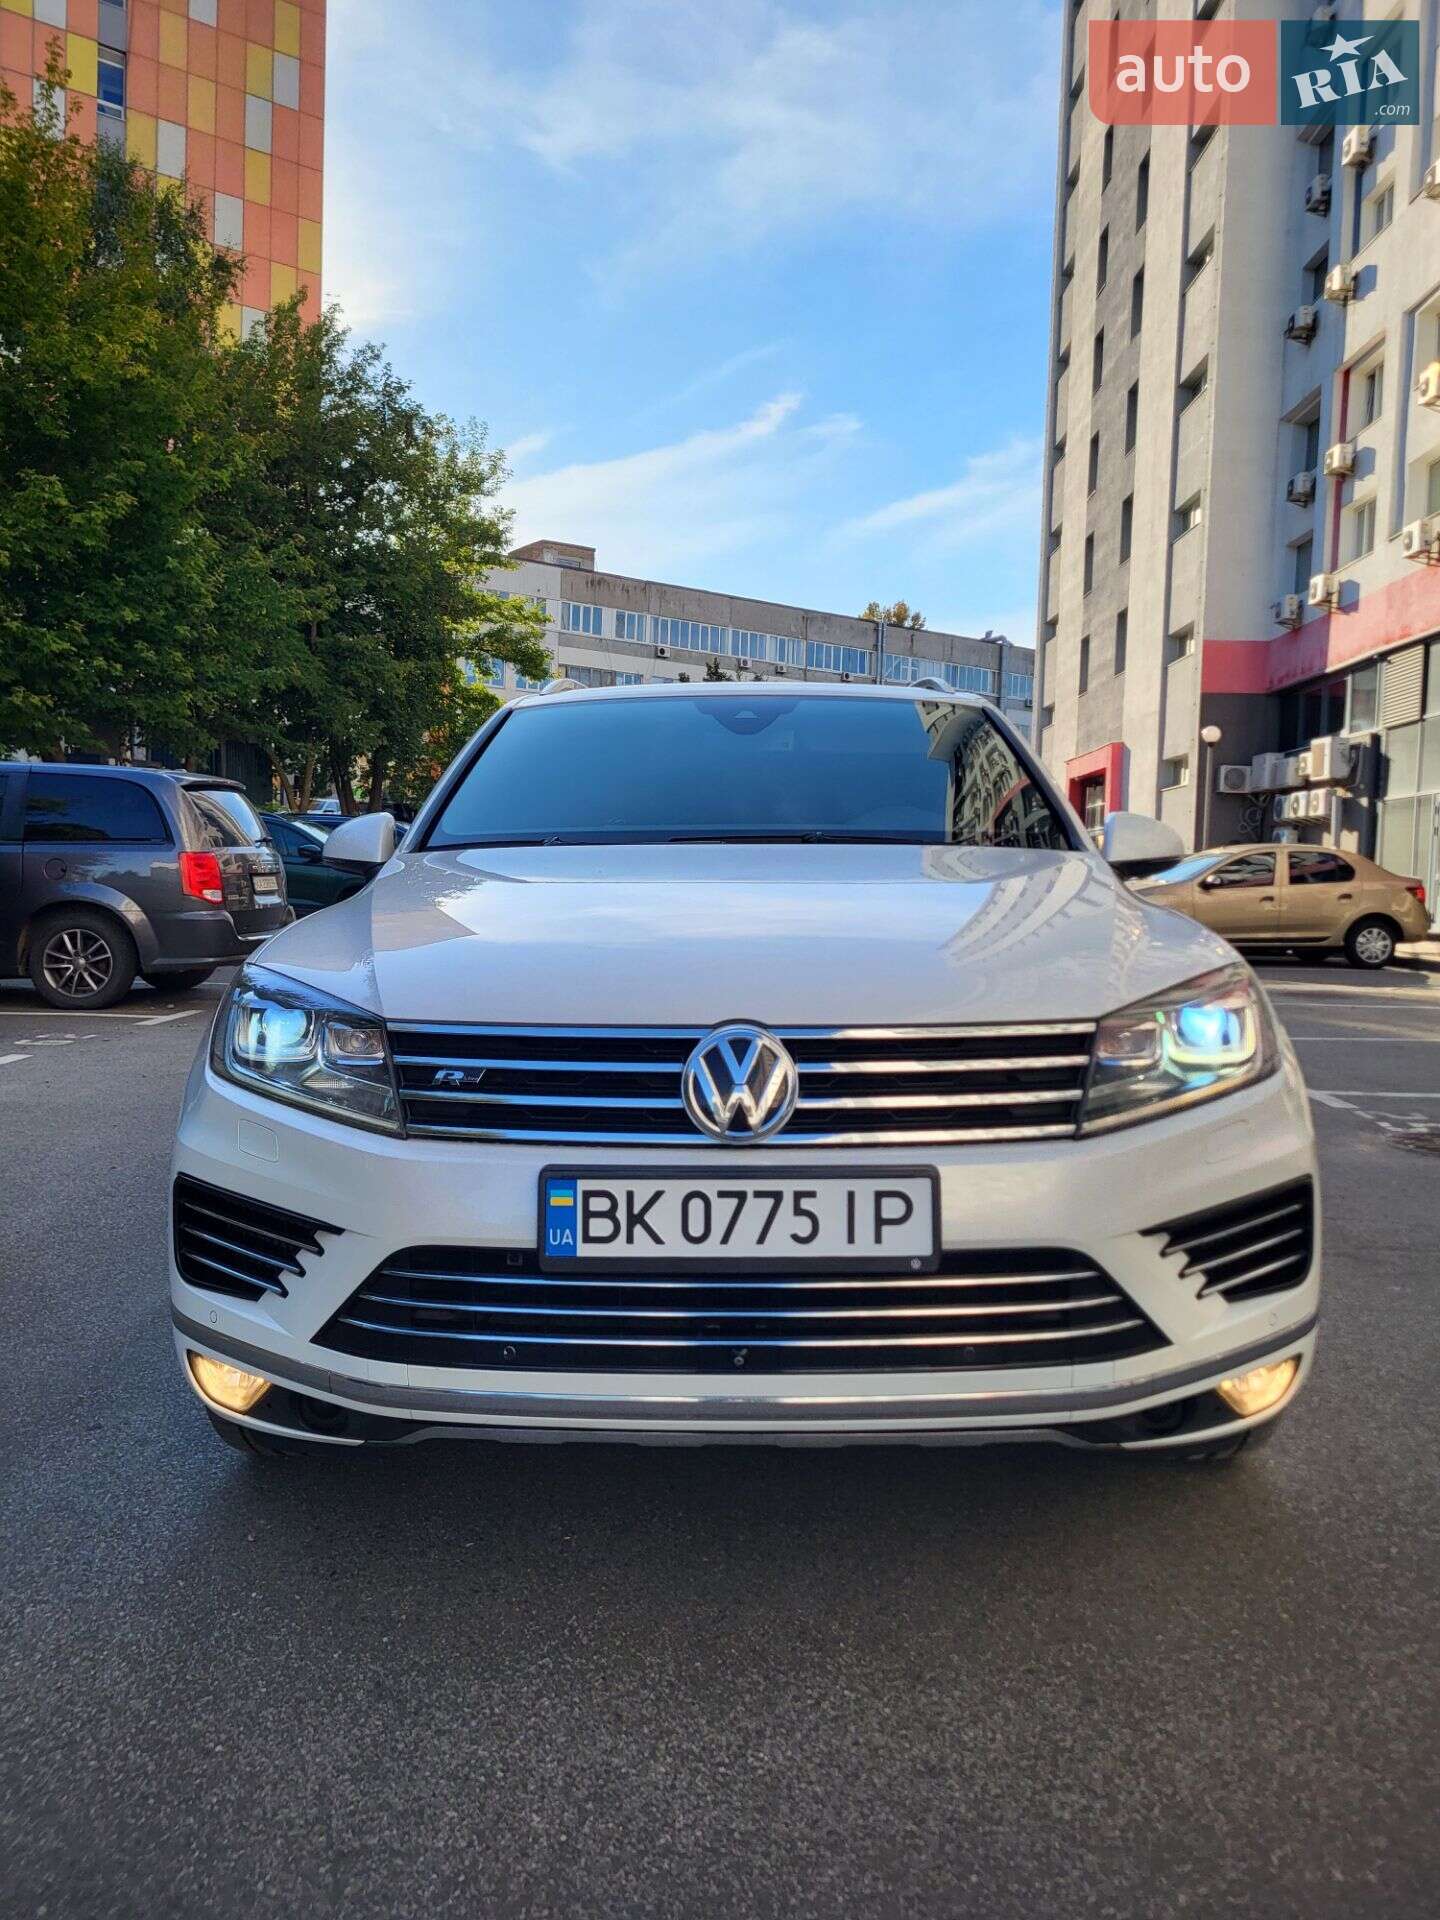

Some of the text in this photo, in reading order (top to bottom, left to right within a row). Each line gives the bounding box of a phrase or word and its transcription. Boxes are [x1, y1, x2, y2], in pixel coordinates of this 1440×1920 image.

[581, 1190, 914, 1244] BK 0775 IP
[549, 1228, 573, 1245] UA
